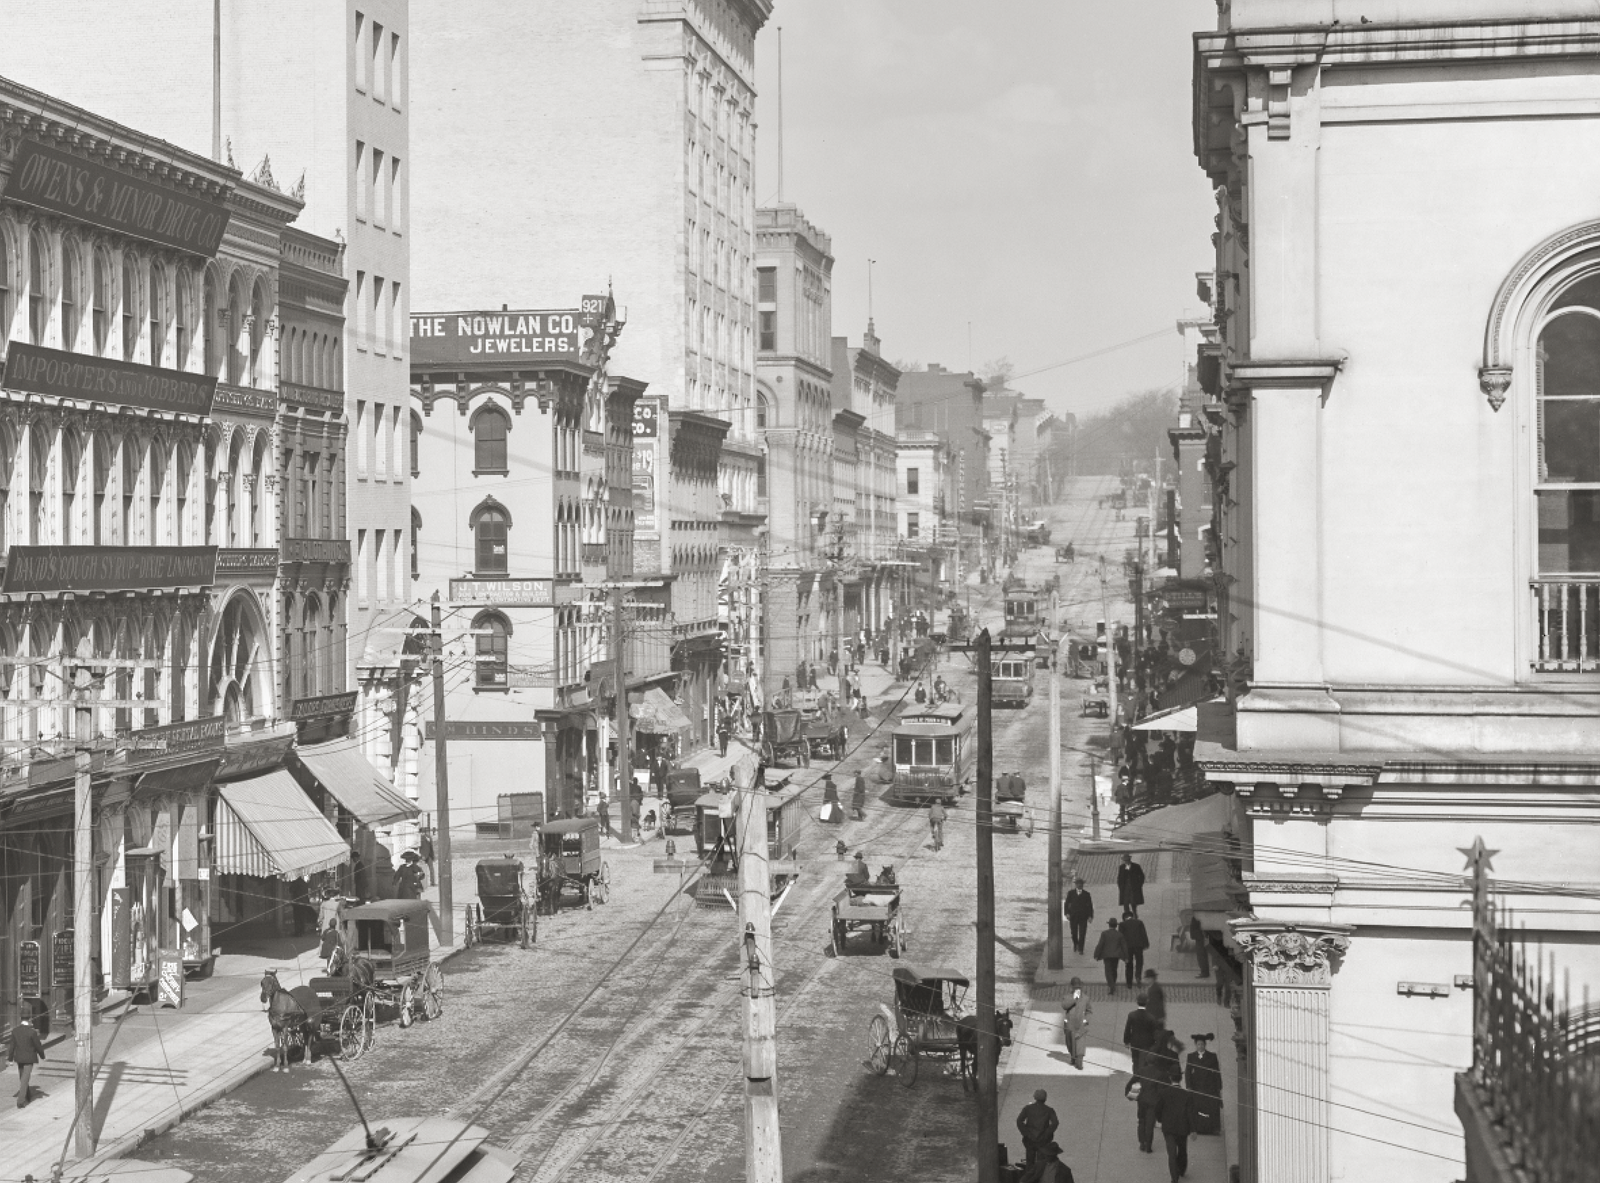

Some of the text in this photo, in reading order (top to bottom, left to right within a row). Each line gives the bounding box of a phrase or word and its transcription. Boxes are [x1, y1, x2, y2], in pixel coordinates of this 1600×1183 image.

[20, 153, 89, 207] OWENS
[85, 176, 105, 212] &
[103, 182, 162, 229] MINOR
[158, 199, 201, 241] DRUG
[582, 299, 602, 313] 921
[410, 315, 577, 337] THE NOWLAN CO.
[470, 337, 575, 353] JEWELERS.
[12, 353, 118, 393] IMPORTERS
[118, 379, 138, 396] AND
[13, 555, 57, 582] DAVID'S
[59, 555, 98, 580] COUGH
